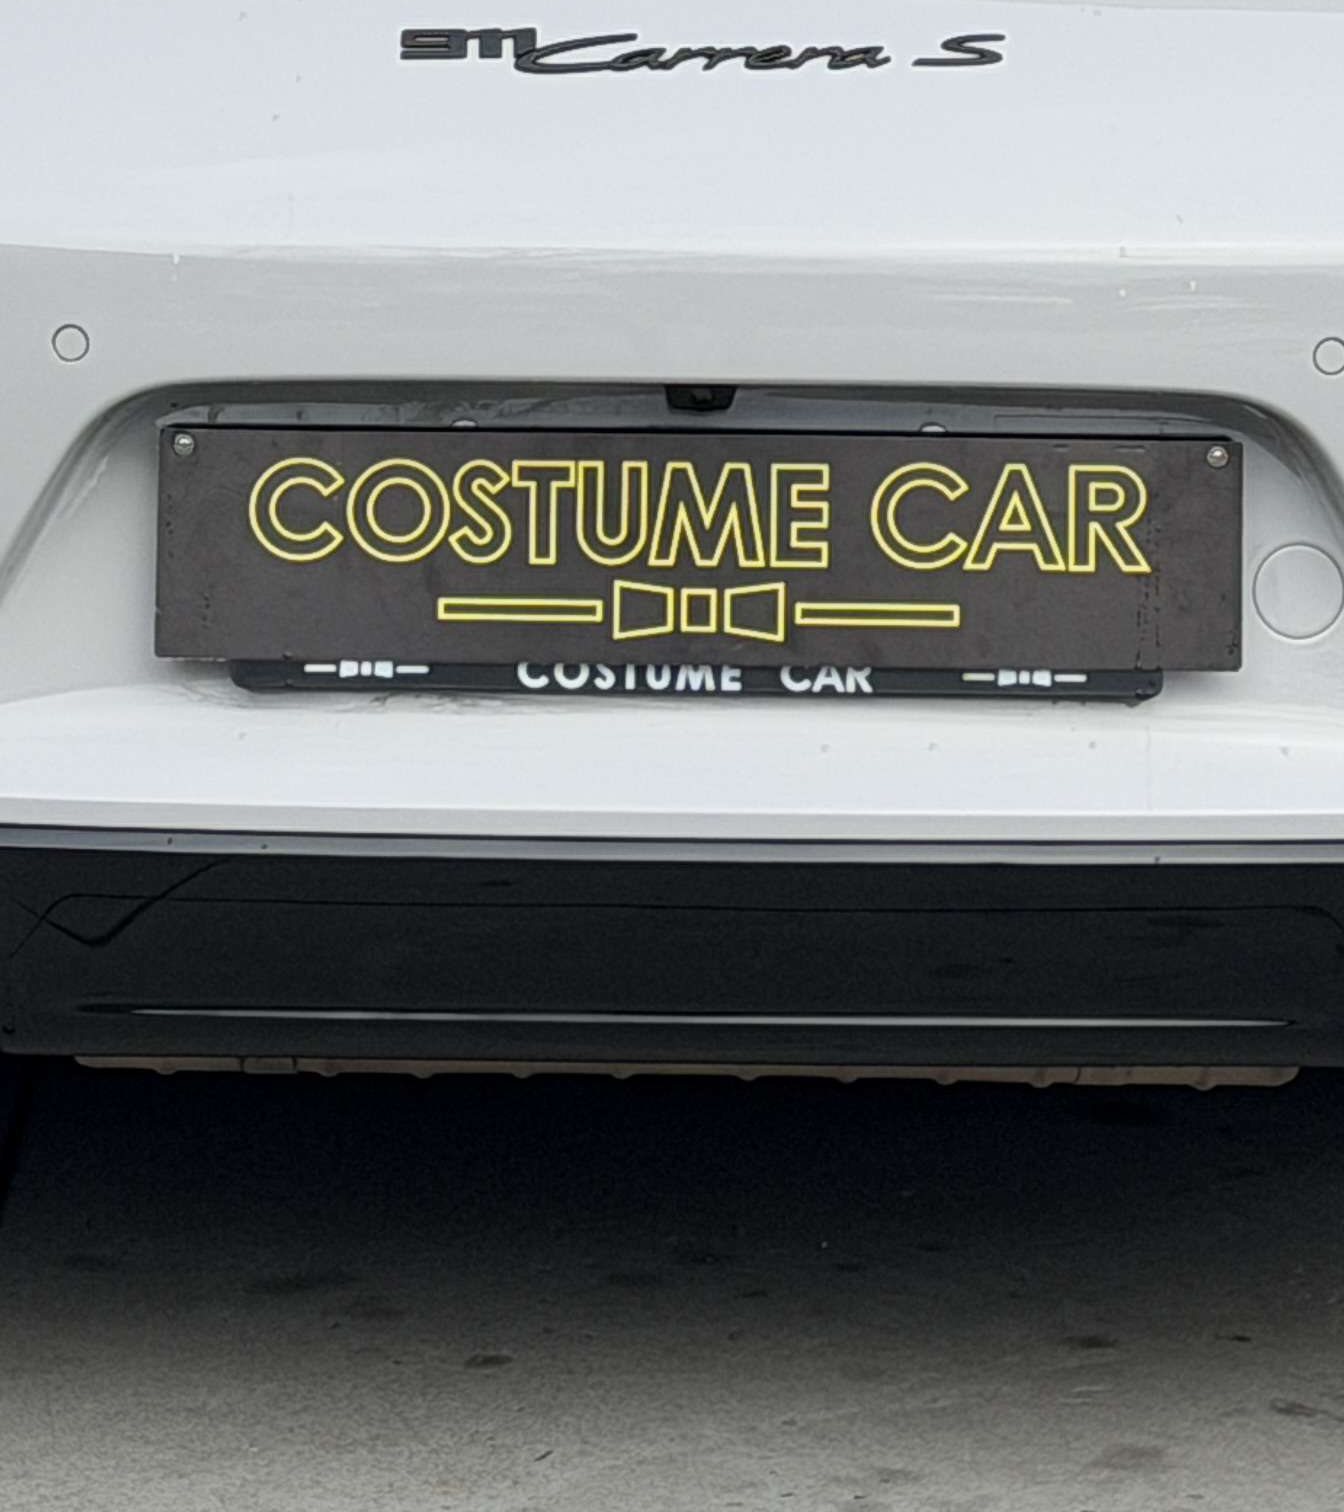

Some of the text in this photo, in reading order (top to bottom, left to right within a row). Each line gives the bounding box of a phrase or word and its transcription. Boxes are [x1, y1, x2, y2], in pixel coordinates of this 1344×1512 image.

[398, 28, 1006, 74] 911 Carrera S
[249, 457, 1152, 573] COSTUME CAR
[780, 665, 873, 693] CAR
